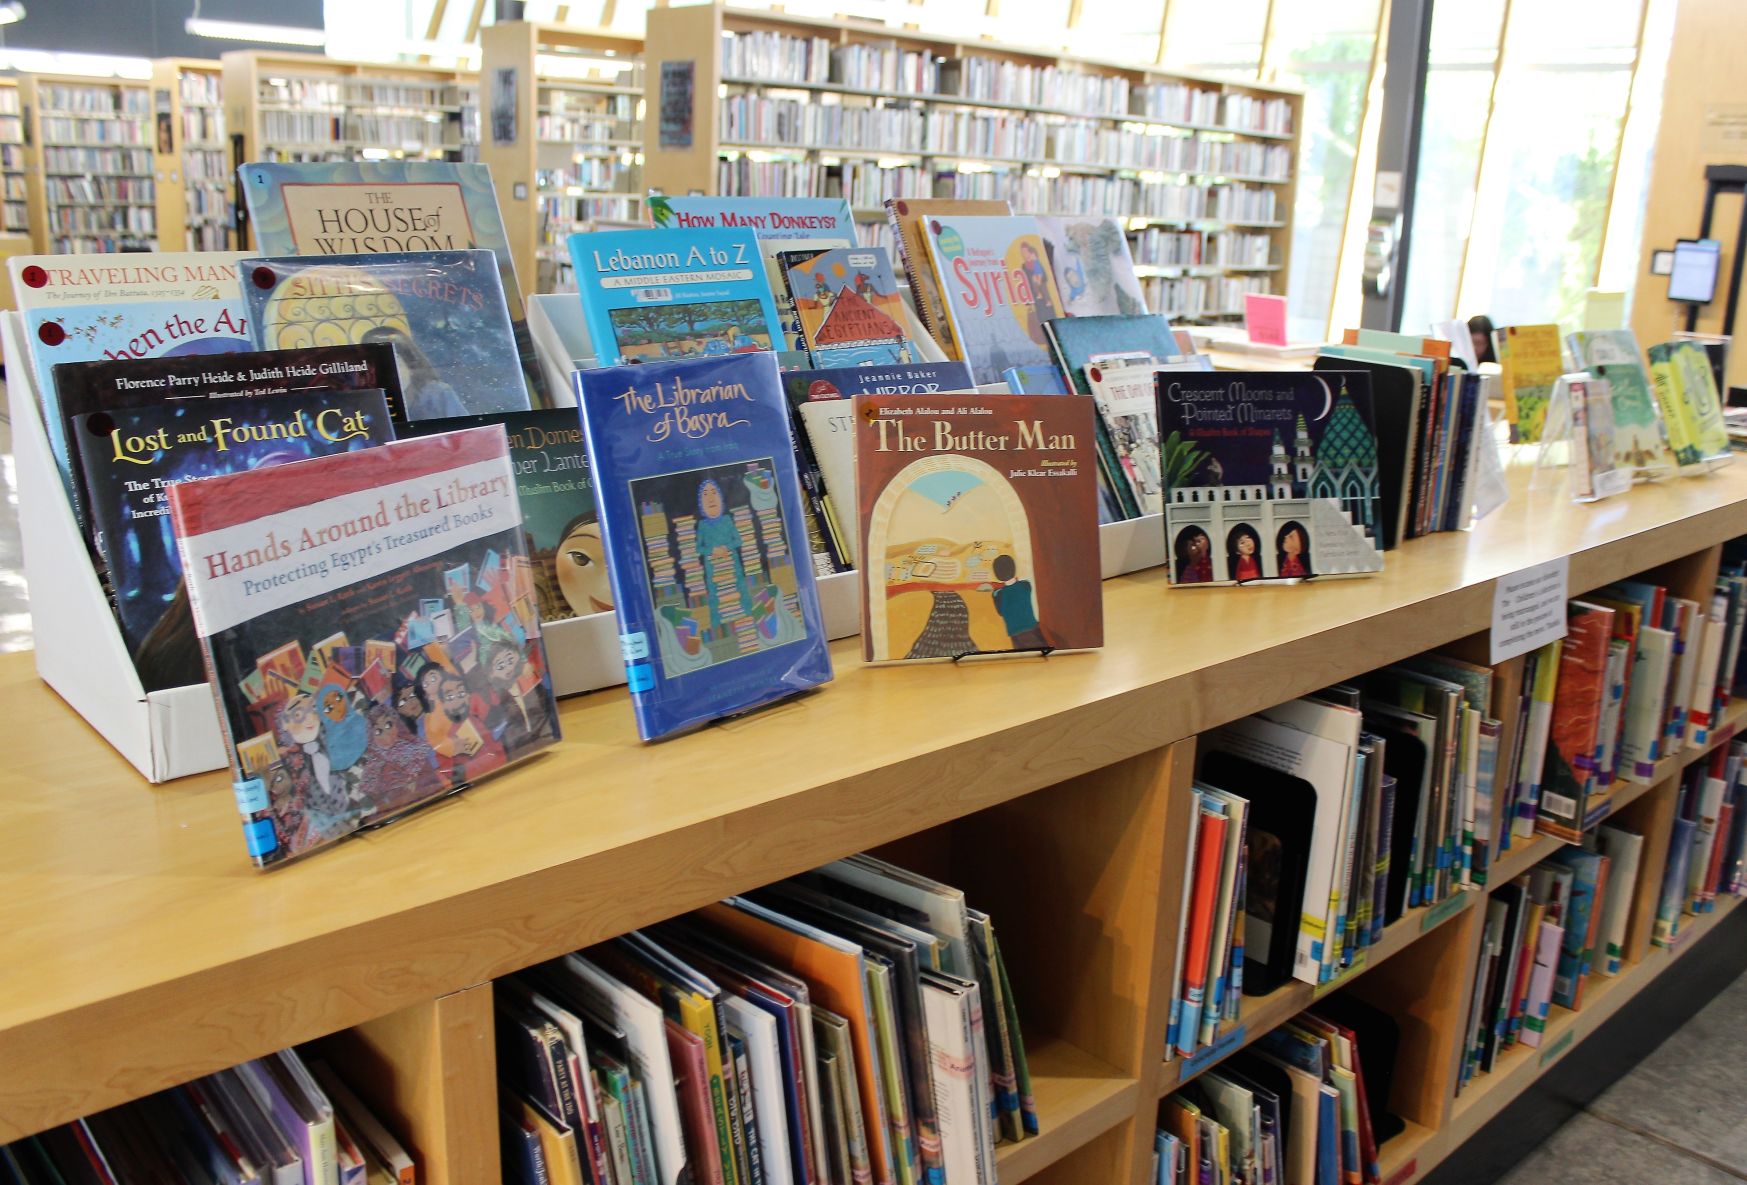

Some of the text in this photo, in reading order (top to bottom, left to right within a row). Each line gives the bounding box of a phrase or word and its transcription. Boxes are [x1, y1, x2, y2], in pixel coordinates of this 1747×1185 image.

[365, 192, 393, 204] THE
[315, 206, 443, 234] HOUSE of
[592, 243, 751, 274] Lebanon A to Z
[46, 266, 185, 286] TRAVELING
[613, 270, 743, 287] A MIDDLE EASTERN MOSAIC
[952, 255, 1036, 318] Syria
[46, 291, 61, 300] The
[62, 291, 91, 301] Journey
[93, 290, 102, 299] of
[383, 278, 485, 313] SECRETS
[102, 328, 165, 362] hen
[164, 313, 208, 340] the
[825, 321, 893, 341] EGYPTIANS
[115, 360, 369, 390] Florence Parry Heide & Judith Heide Gilliland
[858, 370, 937, 384] Jeannie Baker
[244, 390, 254, 399] by
[254, 388, 267, 396] Ted
[266, 386, 288, 396] Lewin
[611, 375, 757, 416] The Librarian
[1167, 382, 1226, 402] Crescent
[1227, 381, 1274, 401] Moons
[1276, 387, 1295, 401] and
[878, 407, 994, 416] Elizabeth Alalou and Ali Alalou
[1180, 402, 1293, 425] Pointed Minarets
[646, 406, 751, 444] of Basra
[868, 418, 1078, 453] The Butter Man
[110, 408, 370, 466] Lost and Found Cat
[512, 450, 591, 476] ver Lante
[1040, 459, 1078, 468] Illustrated by
[1008, 470, 1028, 479] Julie
[1028, 469, 1047, 478] Klear
[123, 480, 151, 492] The
[552, 479, 577, 493] Book
[577, 478, 588, 490] of
[142, 493, 155, 504] of
[131, 506, 171, 519] Incredi
[203, 472, 511, 582] Hands Around the Library
[242, 555, 331, 598] Protecting
[330, 539, 383, 573] Egypt's
[382, 516, 452, 551] Treasured
[452, 504, 495, 531] Books
